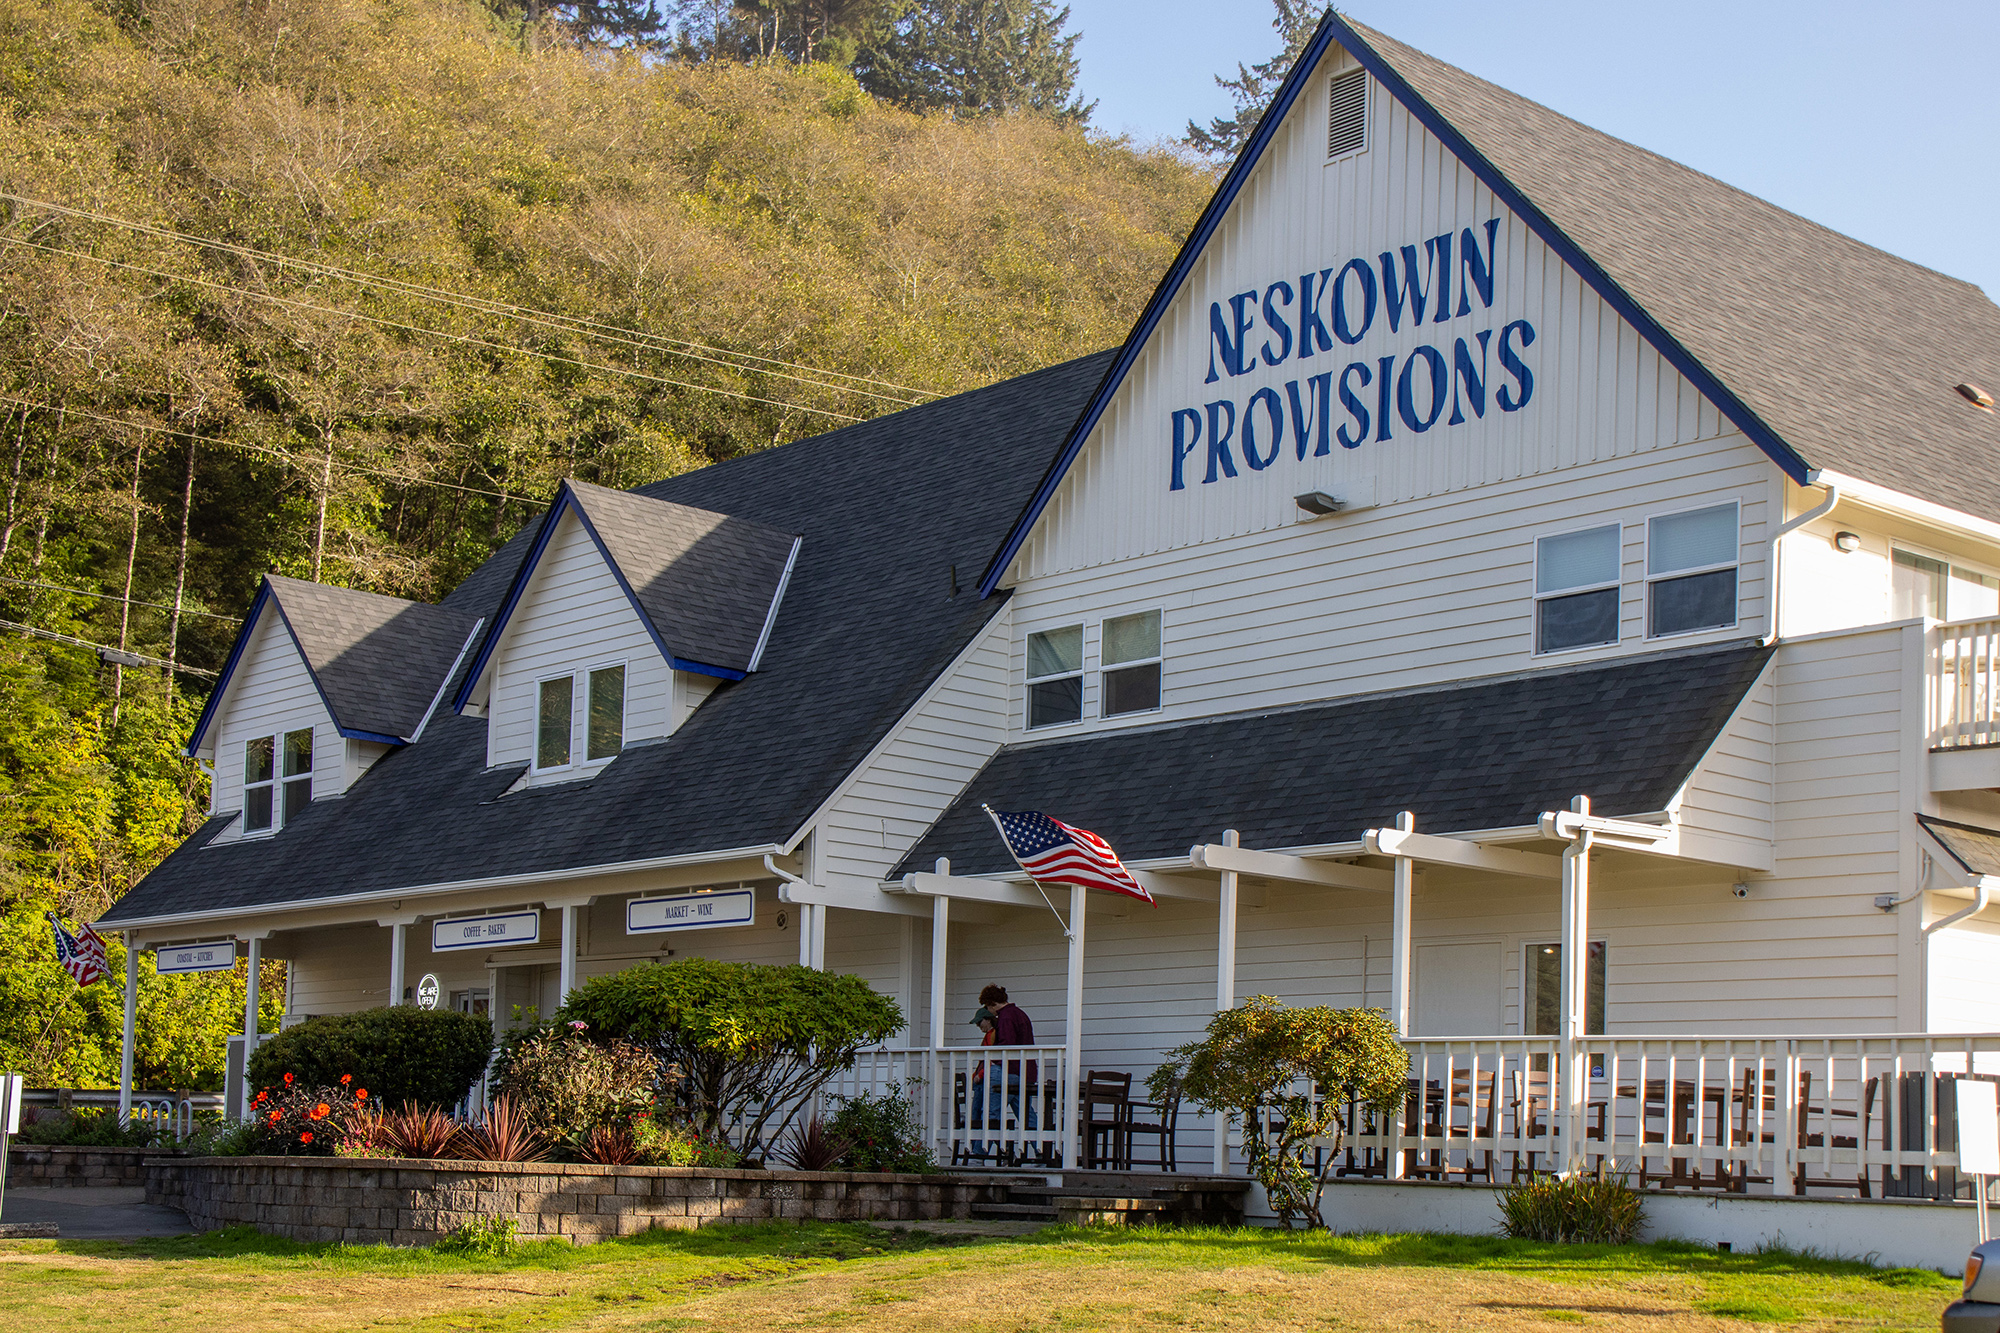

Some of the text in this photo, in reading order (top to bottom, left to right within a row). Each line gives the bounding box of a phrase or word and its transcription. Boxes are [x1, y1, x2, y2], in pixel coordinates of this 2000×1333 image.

[1204, 218, 1500, 384] NESKOWIN
[1169, 319, 1536, 491] PROVISIONS
[665, 905, 689, 919] MARKET
[697, 903, 713, 916] WINE
[463, 926, 481, 938] COFFEE
[488, 923, 506, 935] BAKERY
[420, 987, 437, 996] WE ARE
[421, 996, 434, 1005] OPEN
